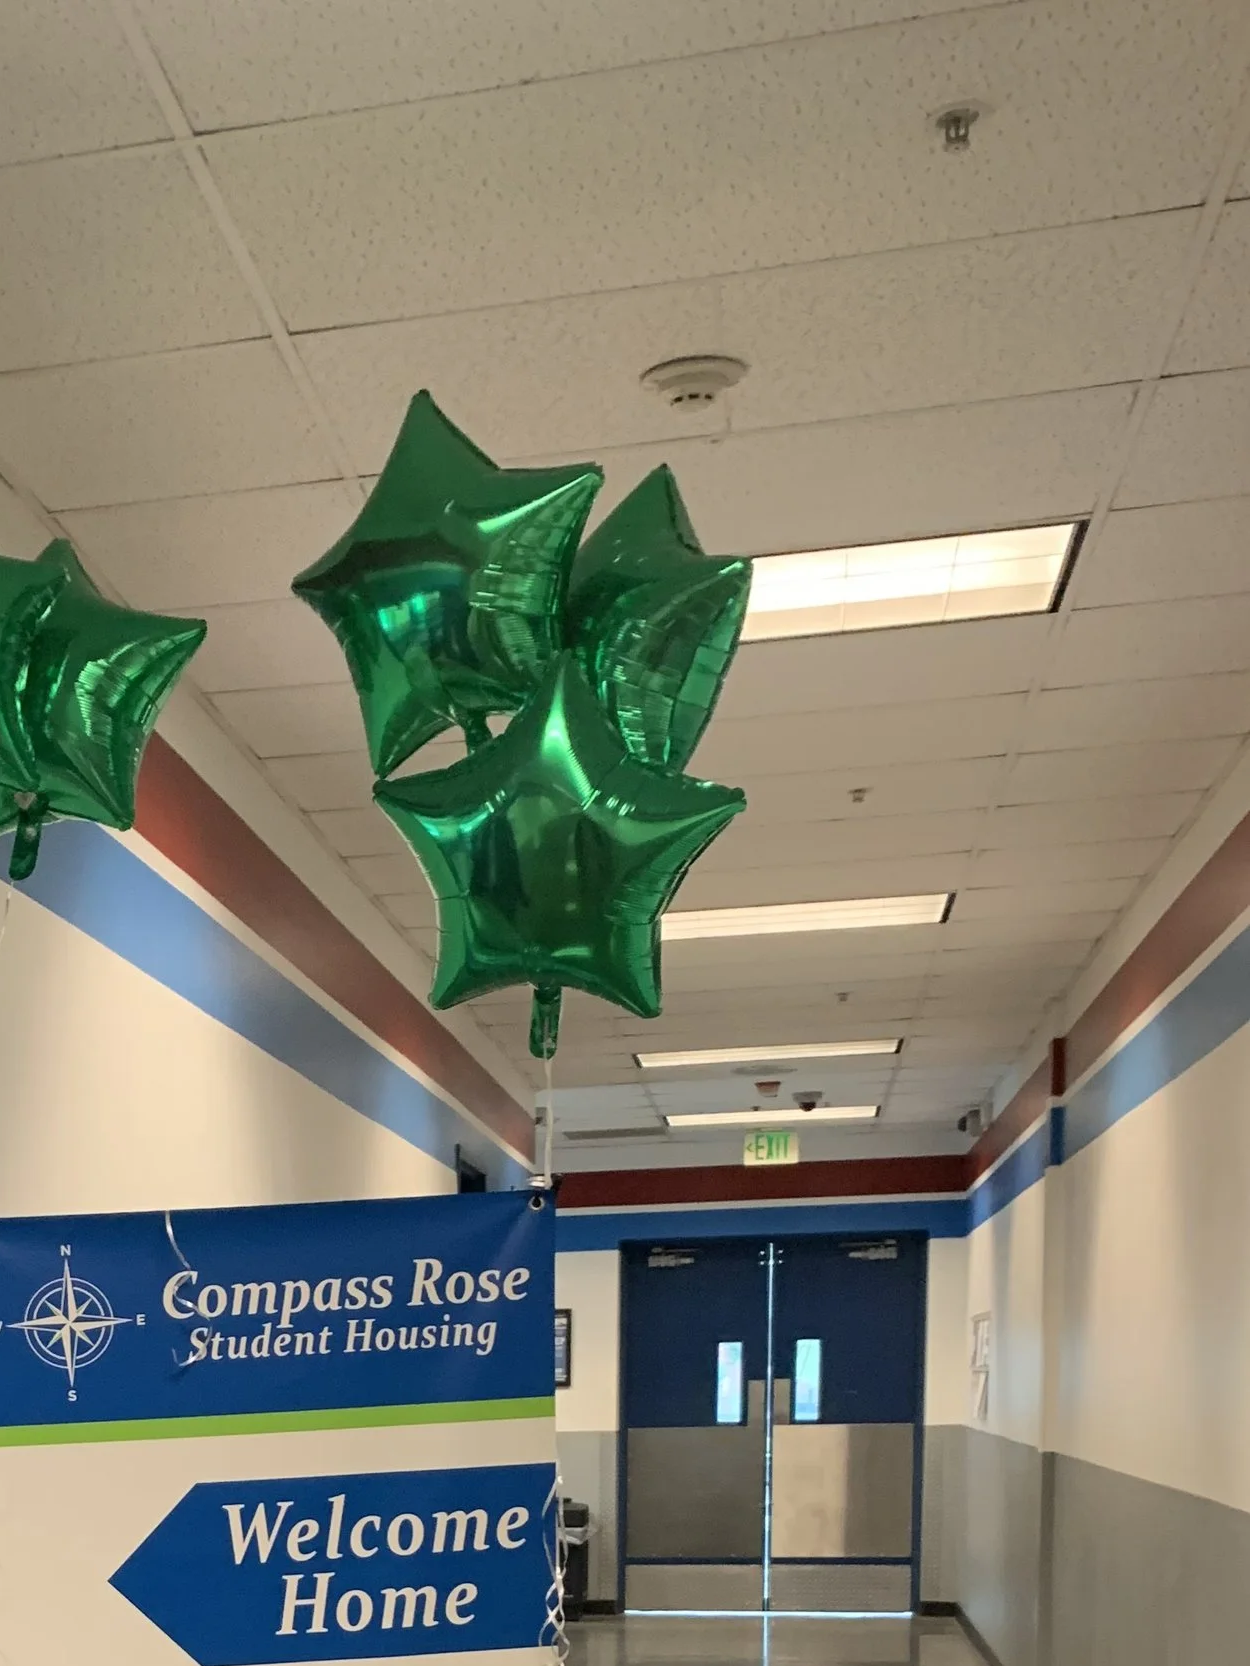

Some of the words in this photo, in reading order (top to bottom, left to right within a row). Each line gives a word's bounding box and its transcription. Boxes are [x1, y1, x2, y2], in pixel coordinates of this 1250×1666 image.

[755, 1133, 790, 1160] EXIT
[60, 1244, 71, 1257] N
[162, 1270, 393, 1329] Compass
[407, 1258, 530, 1306] Rose
[136, 1313, 146, 1326] E
[187, 1326, 333, 1363] Student
[344, 1314, 498, 1356] Housing
[68, 1389, 78, 1402] S
[222, 1494, 529, 1565] Welcome
[275, 1573, 478, 1635] Home
